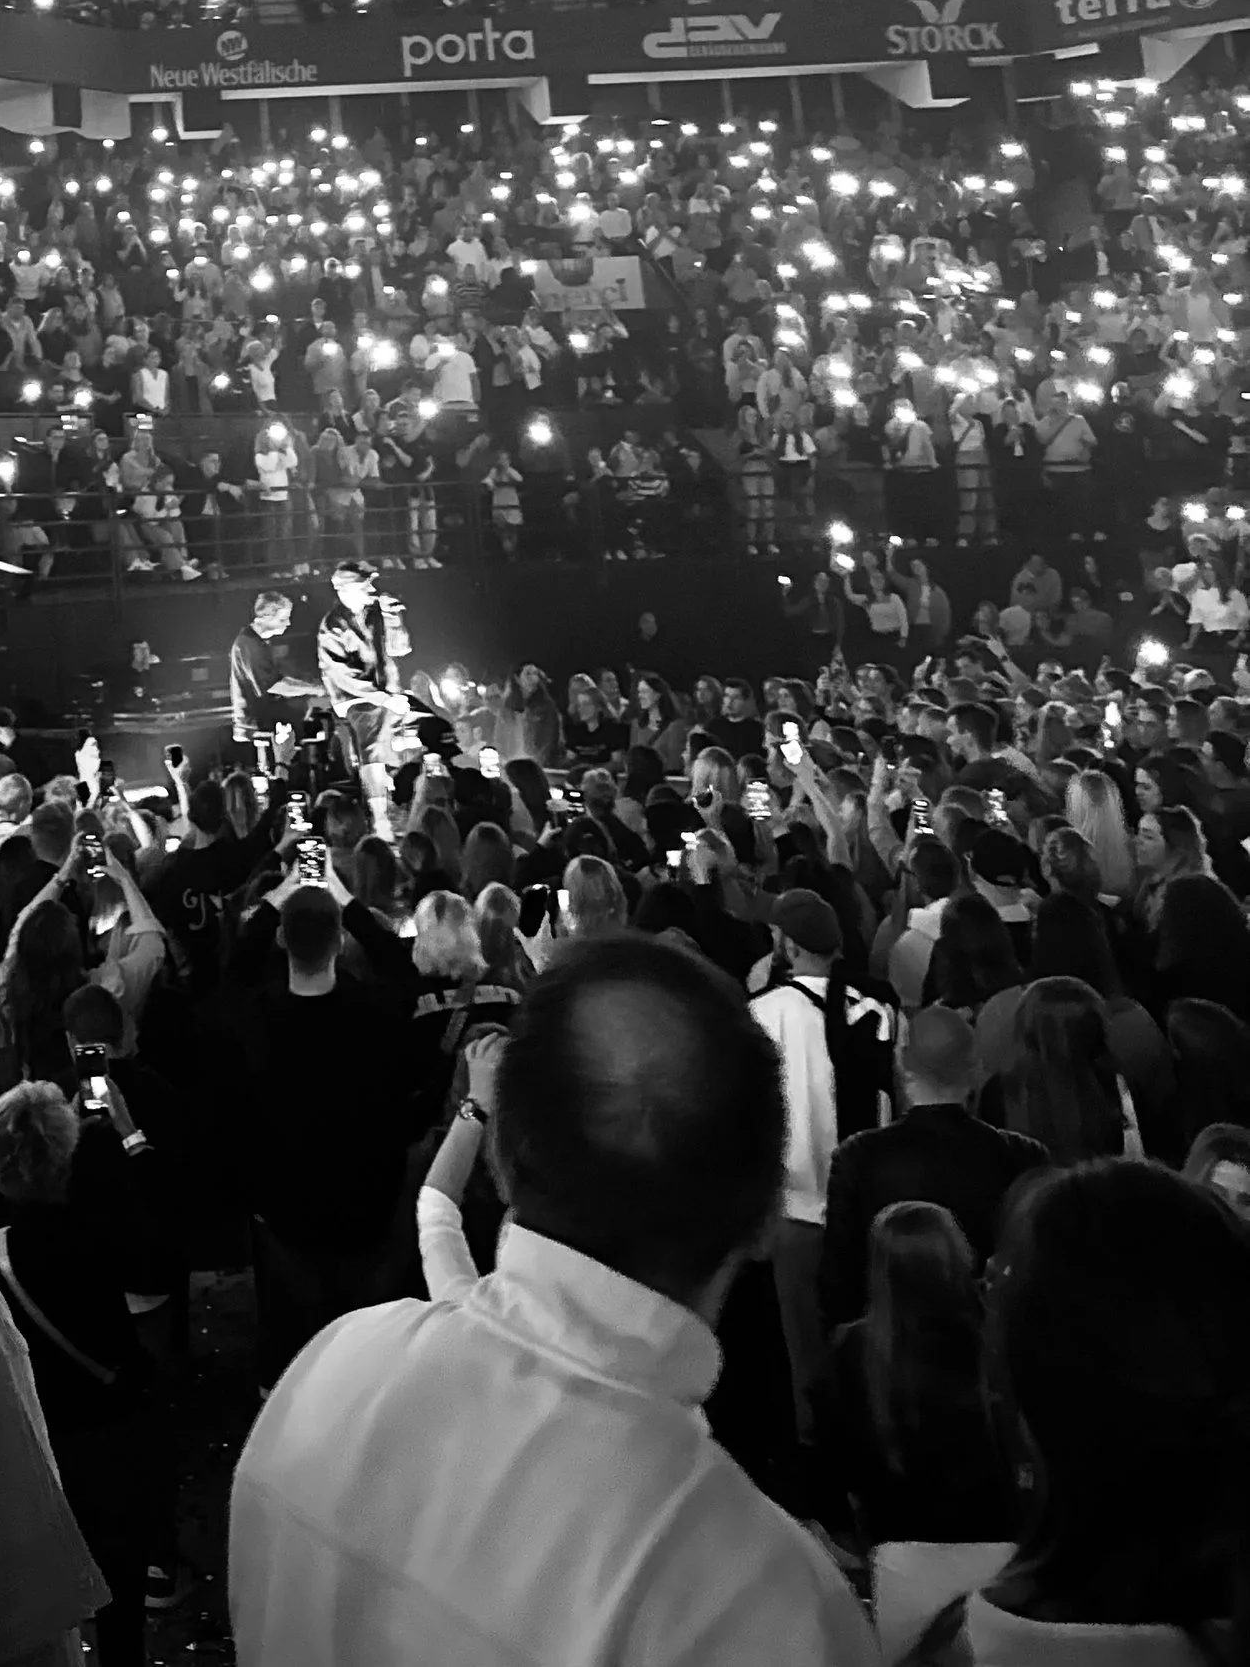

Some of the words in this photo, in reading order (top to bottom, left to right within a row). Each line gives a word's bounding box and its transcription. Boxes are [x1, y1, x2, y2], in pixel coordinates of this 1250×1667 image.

[401, 17, 536, 77] porta
[885, 22, 1005, 54] STORCK
[150, 63, 199, 87] Neue
[200, 59, 319, 85] Westfälische
